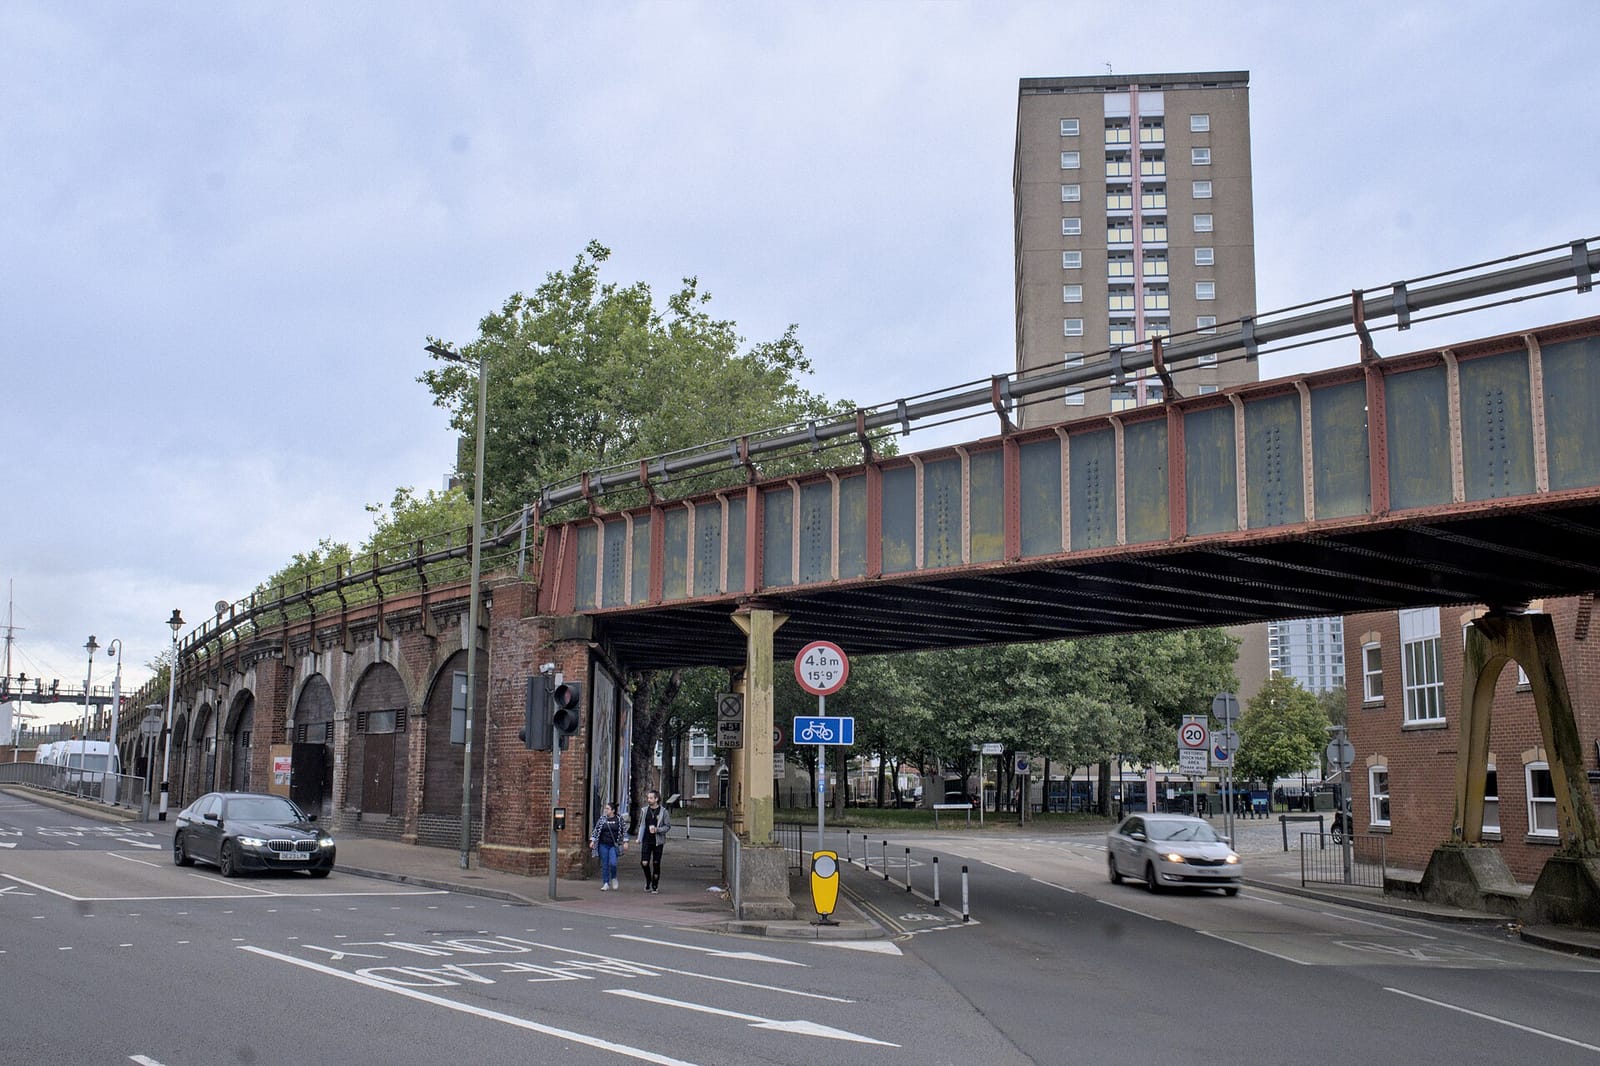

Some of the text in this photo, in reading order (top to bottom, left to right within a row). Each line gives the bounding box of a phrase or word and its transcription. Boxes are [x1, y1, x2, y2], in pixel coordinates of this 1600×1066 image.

[805, 655, 839, 666] 4.8 m
[1185, 730, 1202, 740] 20
[301, 938, 533, 960] ONLY
[355, 959, 663, 987] AHEAD
